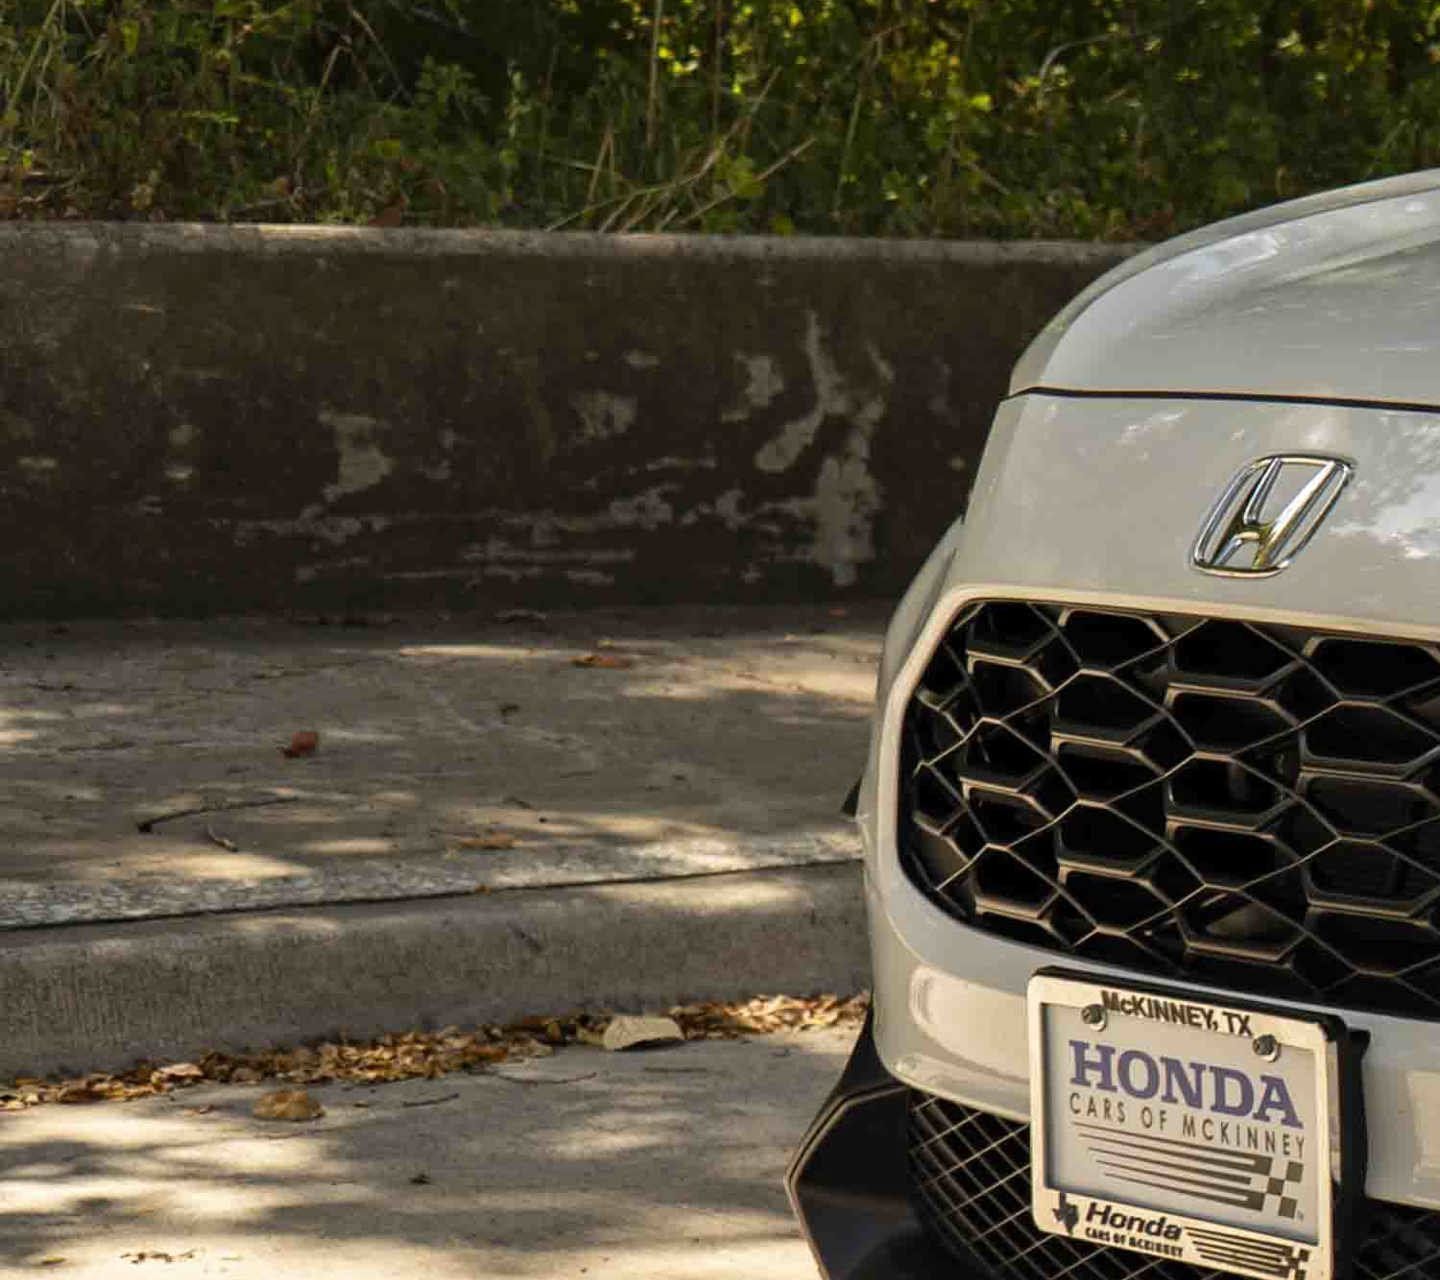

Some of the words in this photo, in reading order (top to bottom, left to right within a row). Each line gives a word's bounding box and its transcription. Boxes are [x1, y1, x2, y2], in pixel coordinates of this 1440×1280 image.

[1100, 990, 1219, 1032] McKINNEY,
[1222, 1011, 1254, 1038] TX
[1068, 1039, 1305, 1130] HONDA
[1069, 1092, 1126, 1123] CARS
[1140, 1106, 1168, 1132] OF
[1181, 1114, 1305, 1159] MCKINNEY
[1085, 1201, 1183, 1241] Honda
[1085, 1226, 1111, 1242] CARS
